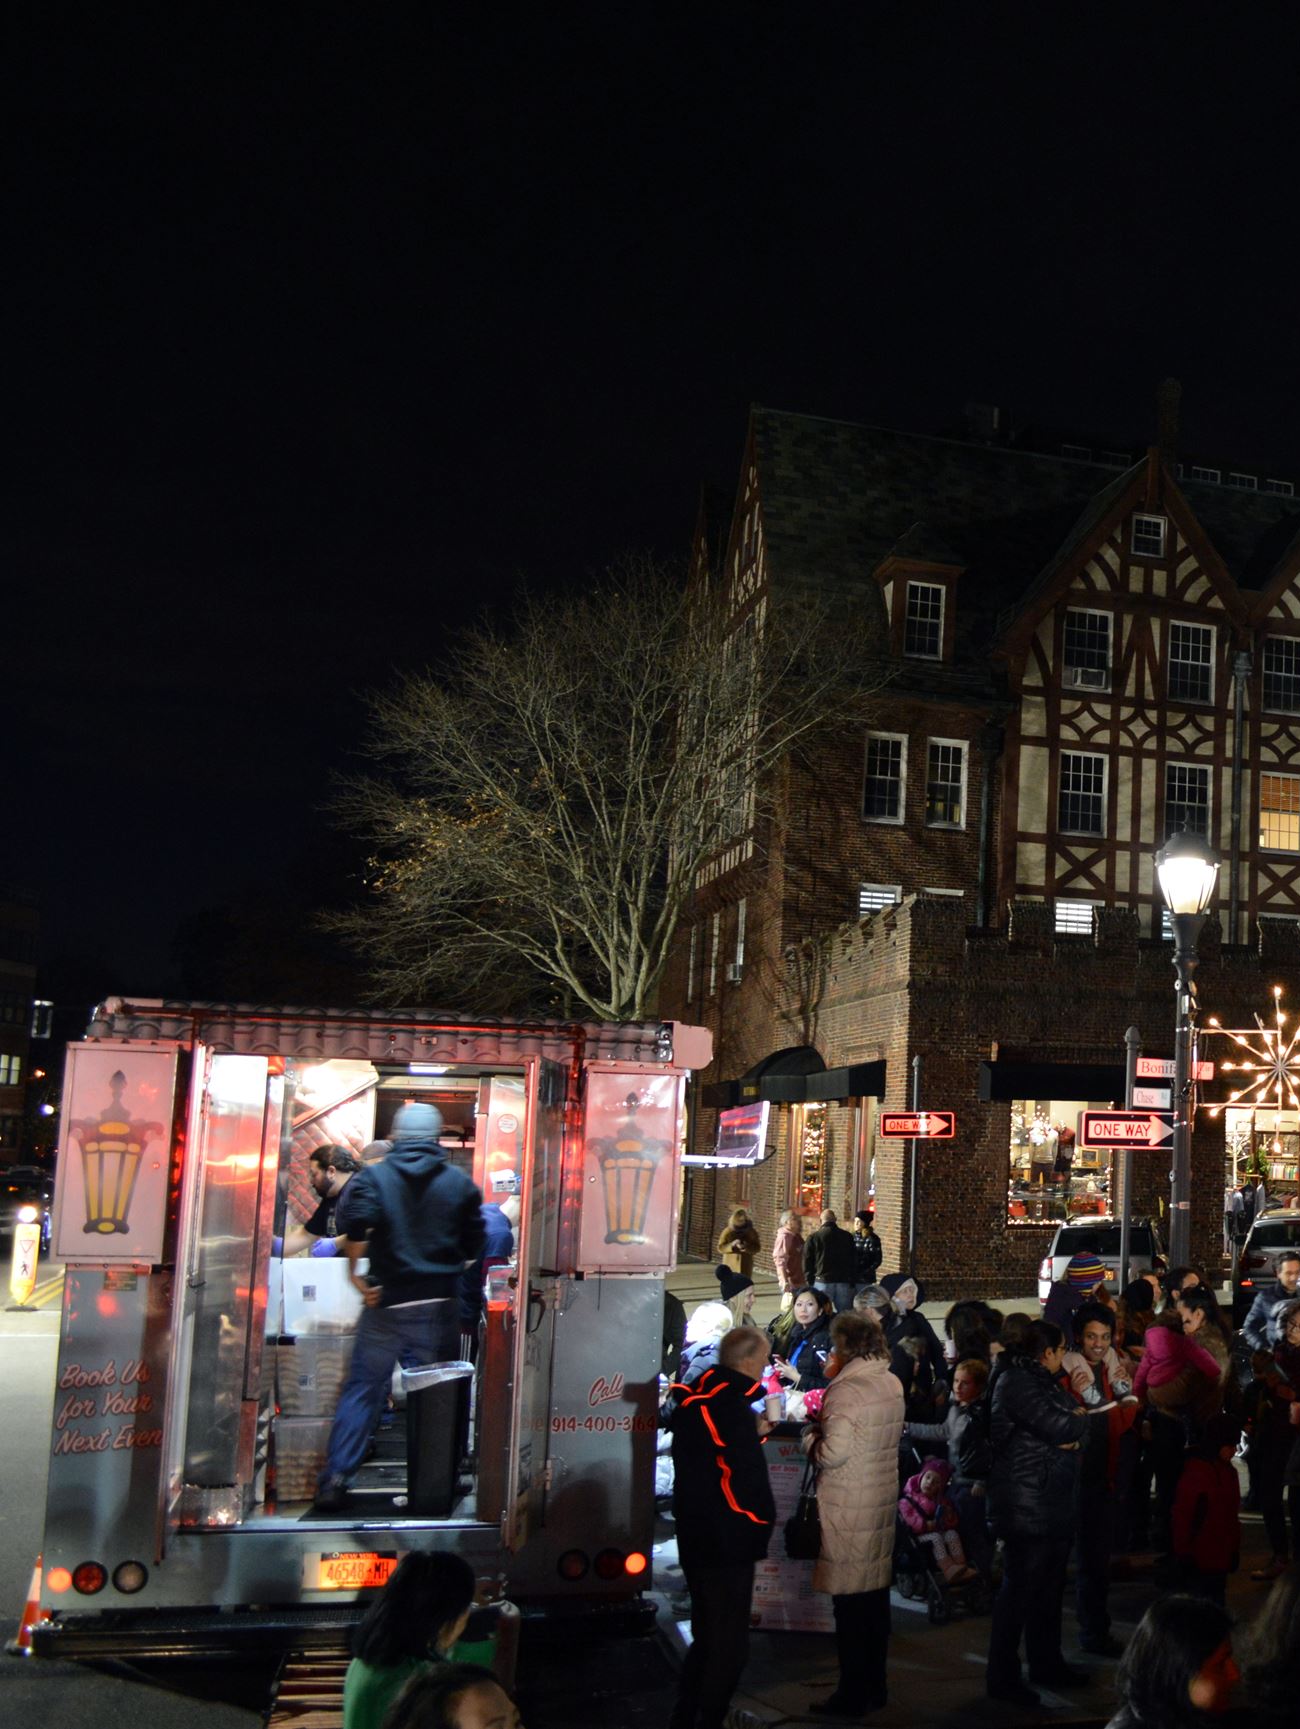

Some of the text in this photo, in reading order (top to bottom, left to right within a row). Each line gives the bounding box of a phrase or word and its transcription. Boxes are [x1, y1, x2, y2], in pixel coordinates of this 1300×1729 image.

[889, 1120, 909, 1130] ONE
[1093, 1122, 1152, 1137] ONE WAY
[59, 1359, 151, 1390] Book Us
[588, 1371, 624, 1407] Call
[56, 1390, 154, 1430] for Your
[551, 1415, 657, 1433] 914-400-3164
[53, 1424, 163, 1456] Next Even
